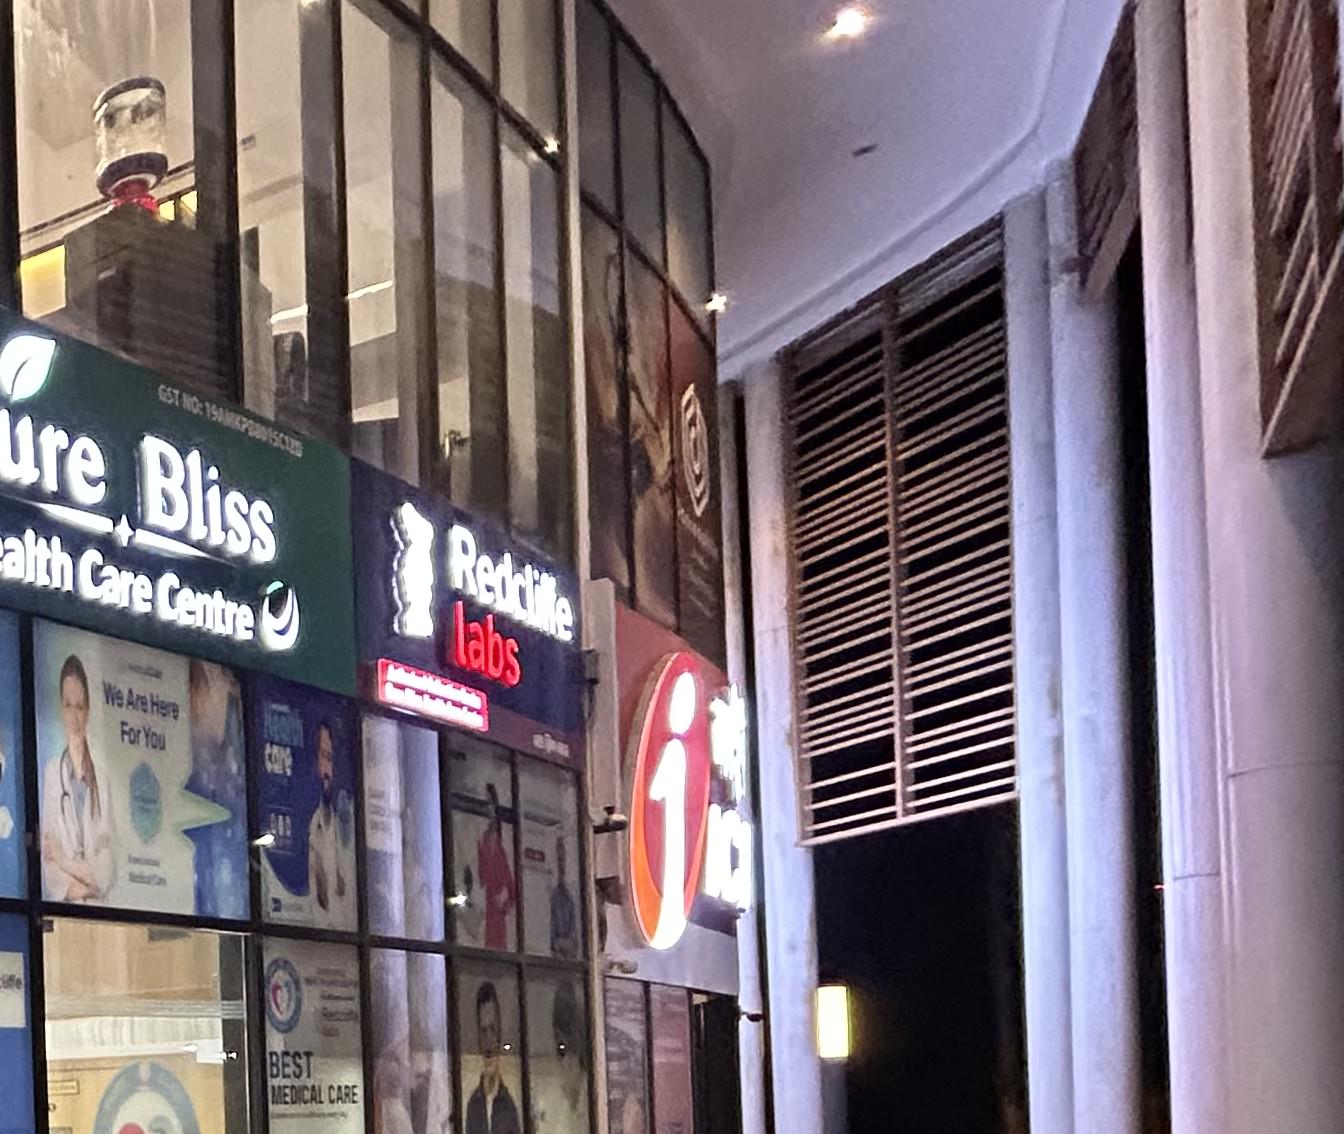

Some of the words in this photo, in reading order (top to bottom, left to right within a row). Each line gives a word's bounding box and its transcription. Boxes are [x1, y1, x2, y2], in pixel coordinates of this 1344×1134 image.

[141, 435, 277, 563] Bliss
[79, 549, 153, 613] Care
[158, 572, 255, 640] Centre
[455, 600, 521, 688] labs
[104, 682, 124, 707] We
[126, 688, 149, 713] Are
[150, 697, 179, 720] Here
[121, 721, 141, 745] For
[142, 727, 166, 750] You
[269, 1051, 313, 1079] BEST
[271, 1085, 324, 1105] MEDICAL
[328, 1084, 359, 1104] CARE
